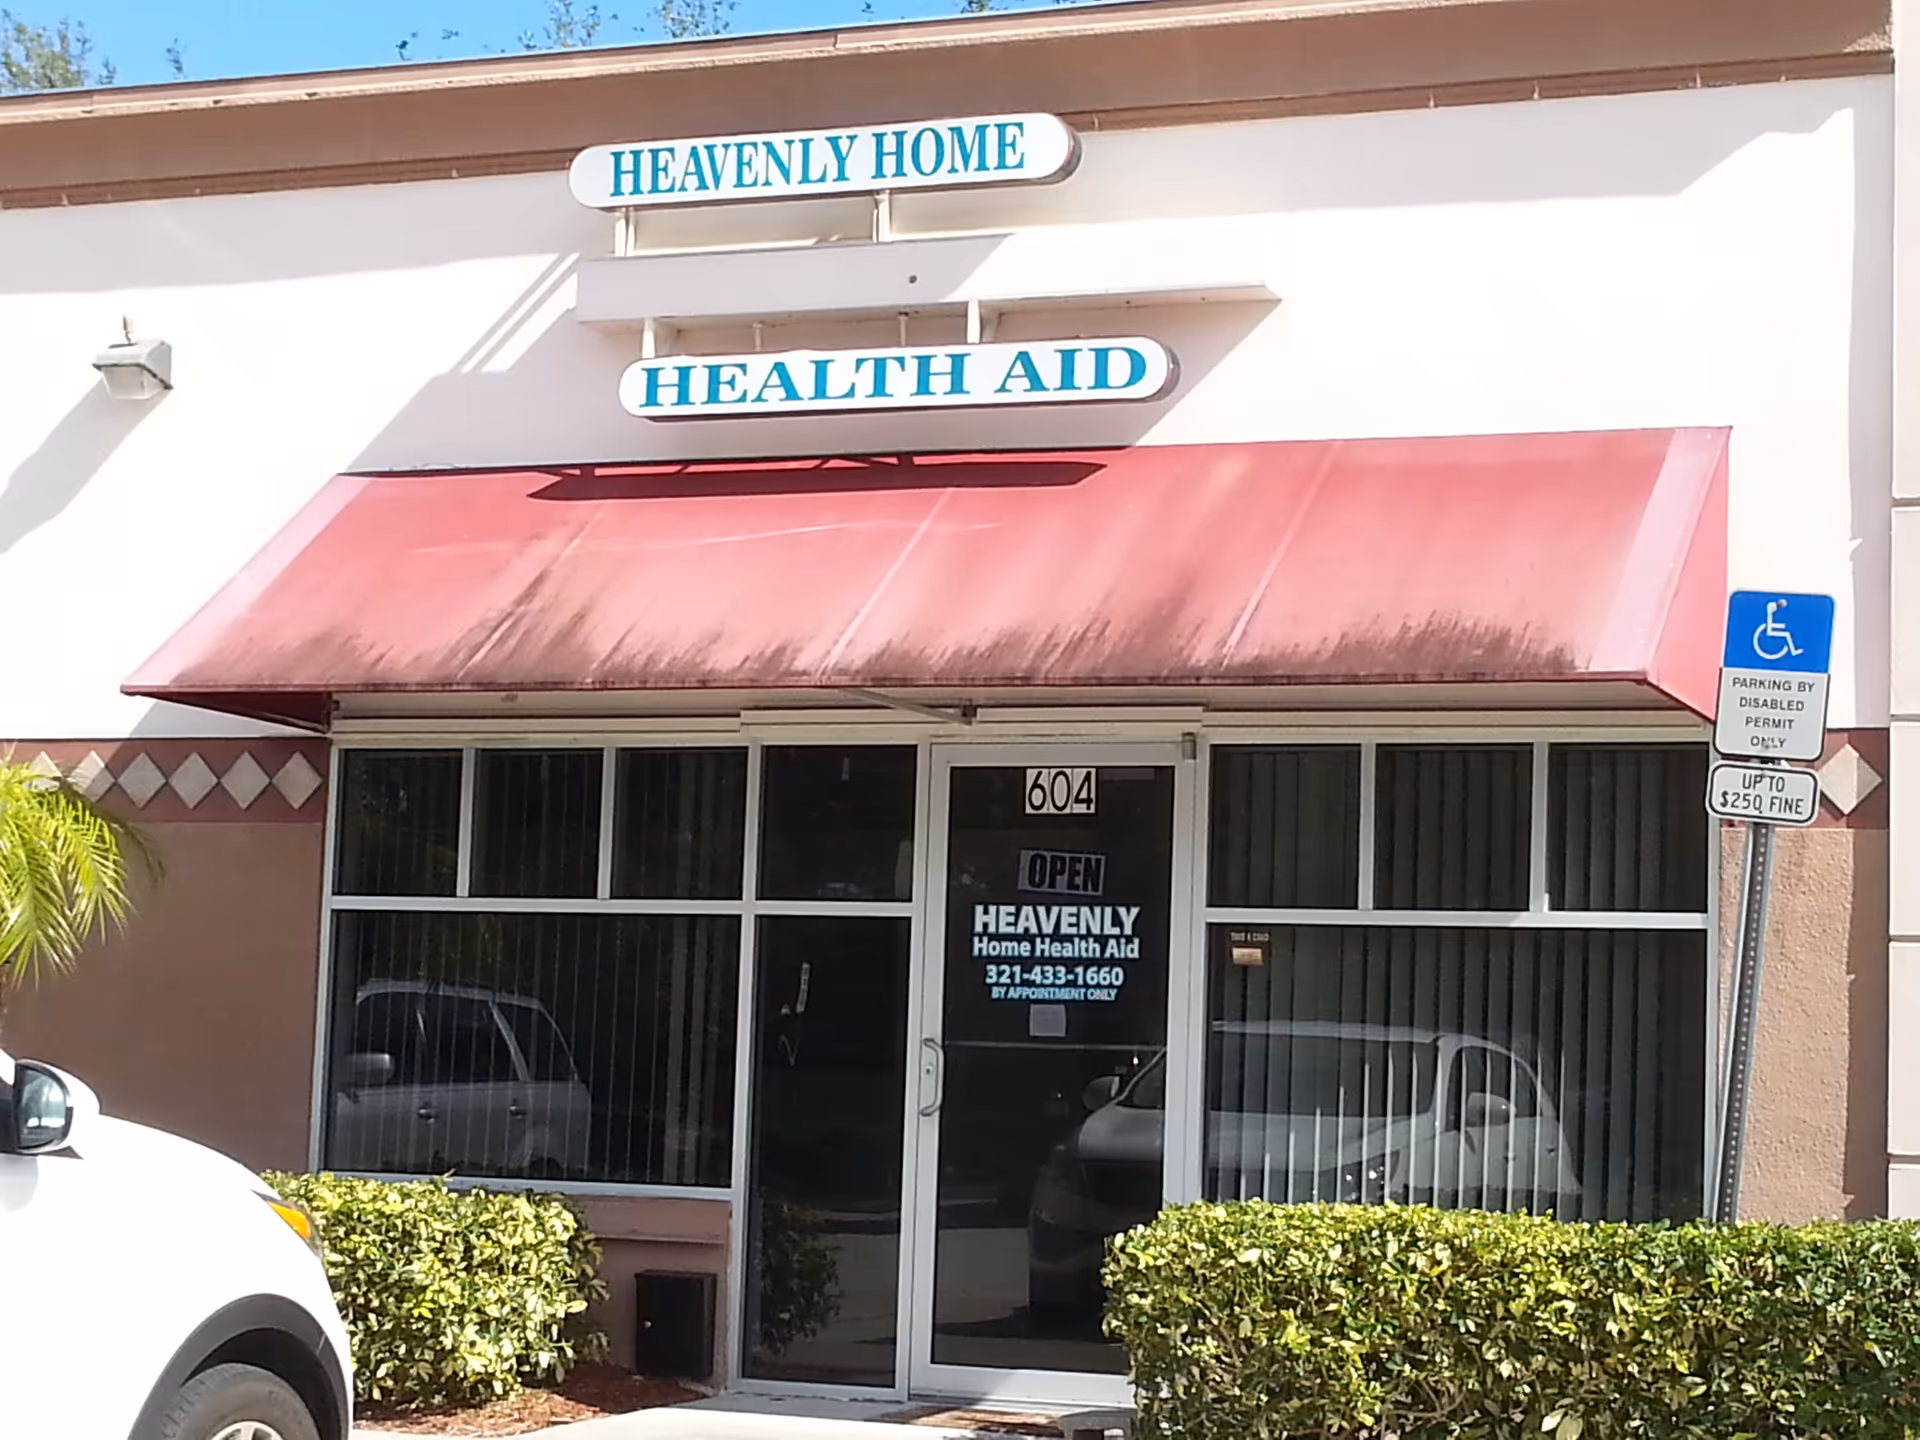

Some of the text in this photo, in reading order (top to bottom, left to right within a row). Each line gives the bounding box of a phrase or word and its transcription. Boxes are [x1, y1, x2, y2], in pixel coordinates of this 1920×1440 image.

[609, 121, 1025, 198] HEAVENLY HOME
[638, 346, 1147, 408] HEALTH AID
[1732, 676, 1815, 693] PARKING BY
[1739, 697, 1805, 712] DISABLED
[1745, 716, 1795, 730] PERMIT
[1750, 735, 1787, 749] ONLY
[1027, 770, 1094, 812] 604
[1742, 772, 1785, 793] UP TO
[1769, 796, 1805, 815] FINE
[1027, 853, 1101, 892] OPEN
[974, 904, 1140, 935] HEAVENLY
[972, 936, 1140, 959] Home Health Aid
[985, 965, 1124, 986] 321-433-1660
[991, 986, 1118, 1001] BY APPOINTMENT ONLY
